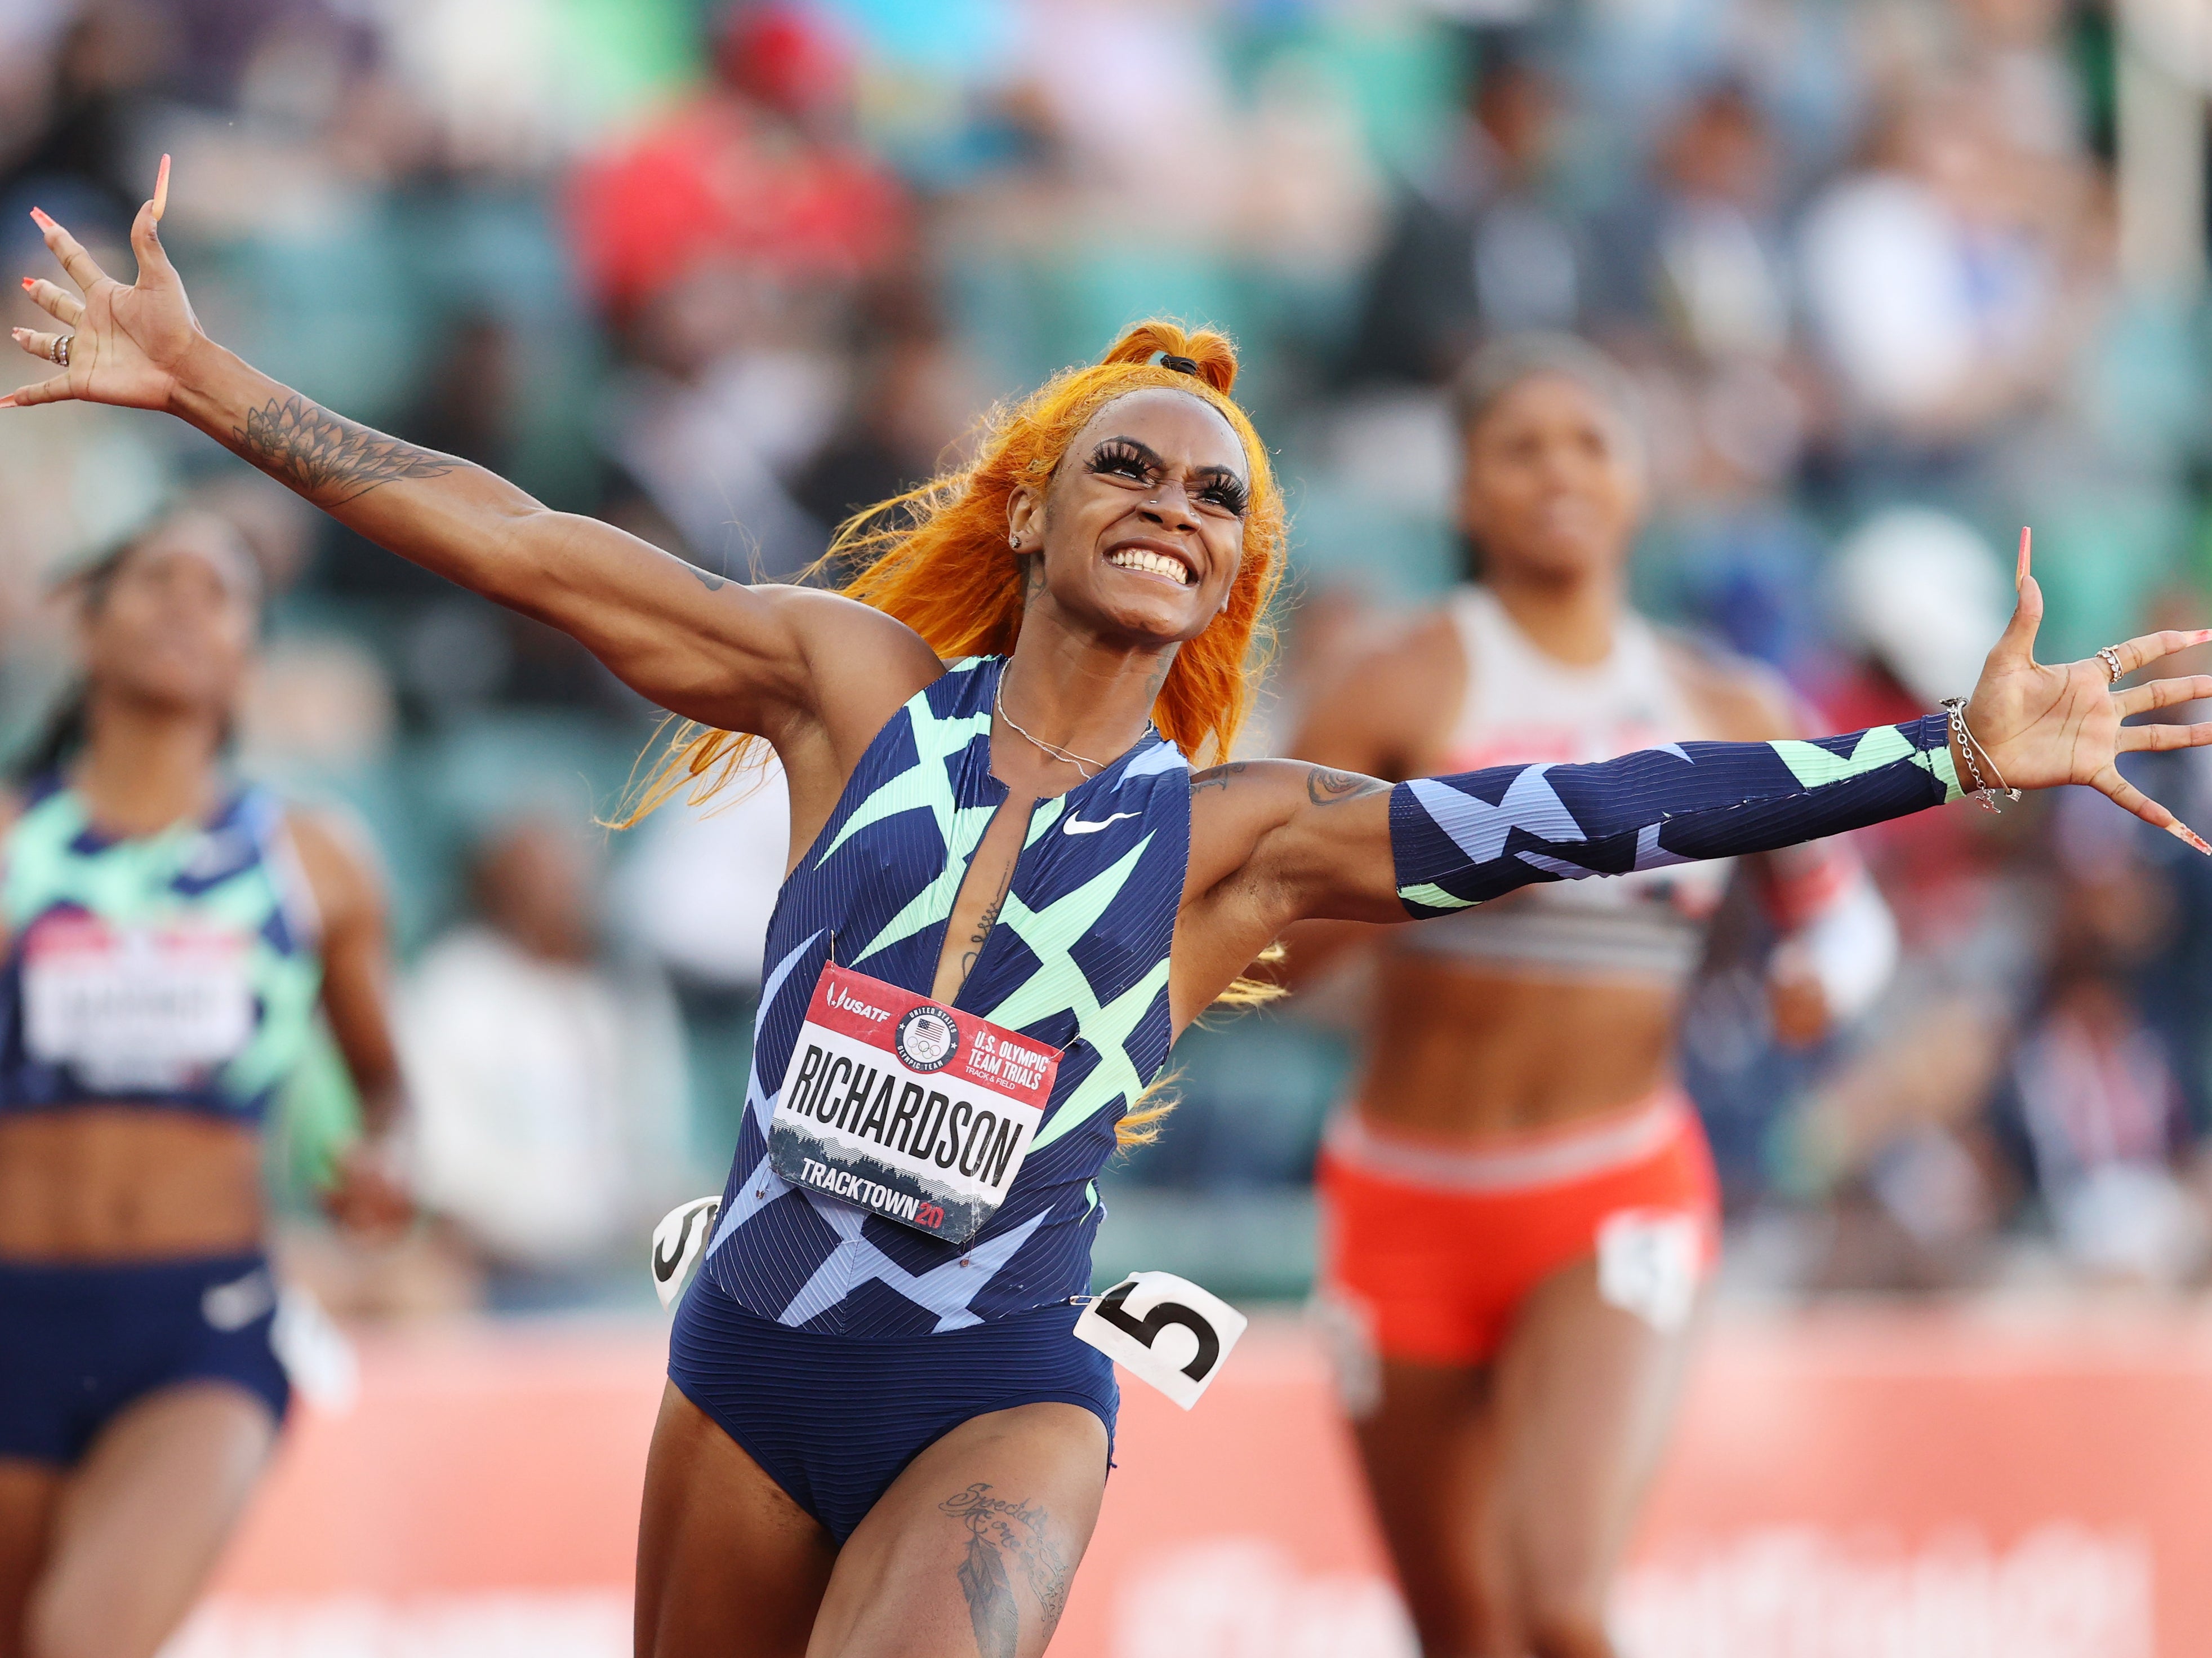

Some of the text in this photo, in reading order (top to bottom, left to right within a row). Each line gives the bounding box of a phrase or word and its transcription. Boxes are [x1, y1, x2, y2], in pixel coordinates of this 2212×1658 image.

[842, 998, 891, 1023] USATF
[909, 1007, 958, 1034] UNITED STATES
[897, 1044, 944, 1070] OLYMPIC TEAM
[974, 1030, 1049, 1073] U.S. OLYMPIC
[965, 1065, 990, 1081] TRACK
[996, 1078, 1016, 1090] FIELD
[968, 1048, 1042, 1091] TEAM TRIALS
[786, 1044, 1024, 1188] RICHARDSON
[1094, 1281, 1220, 1384] 5
